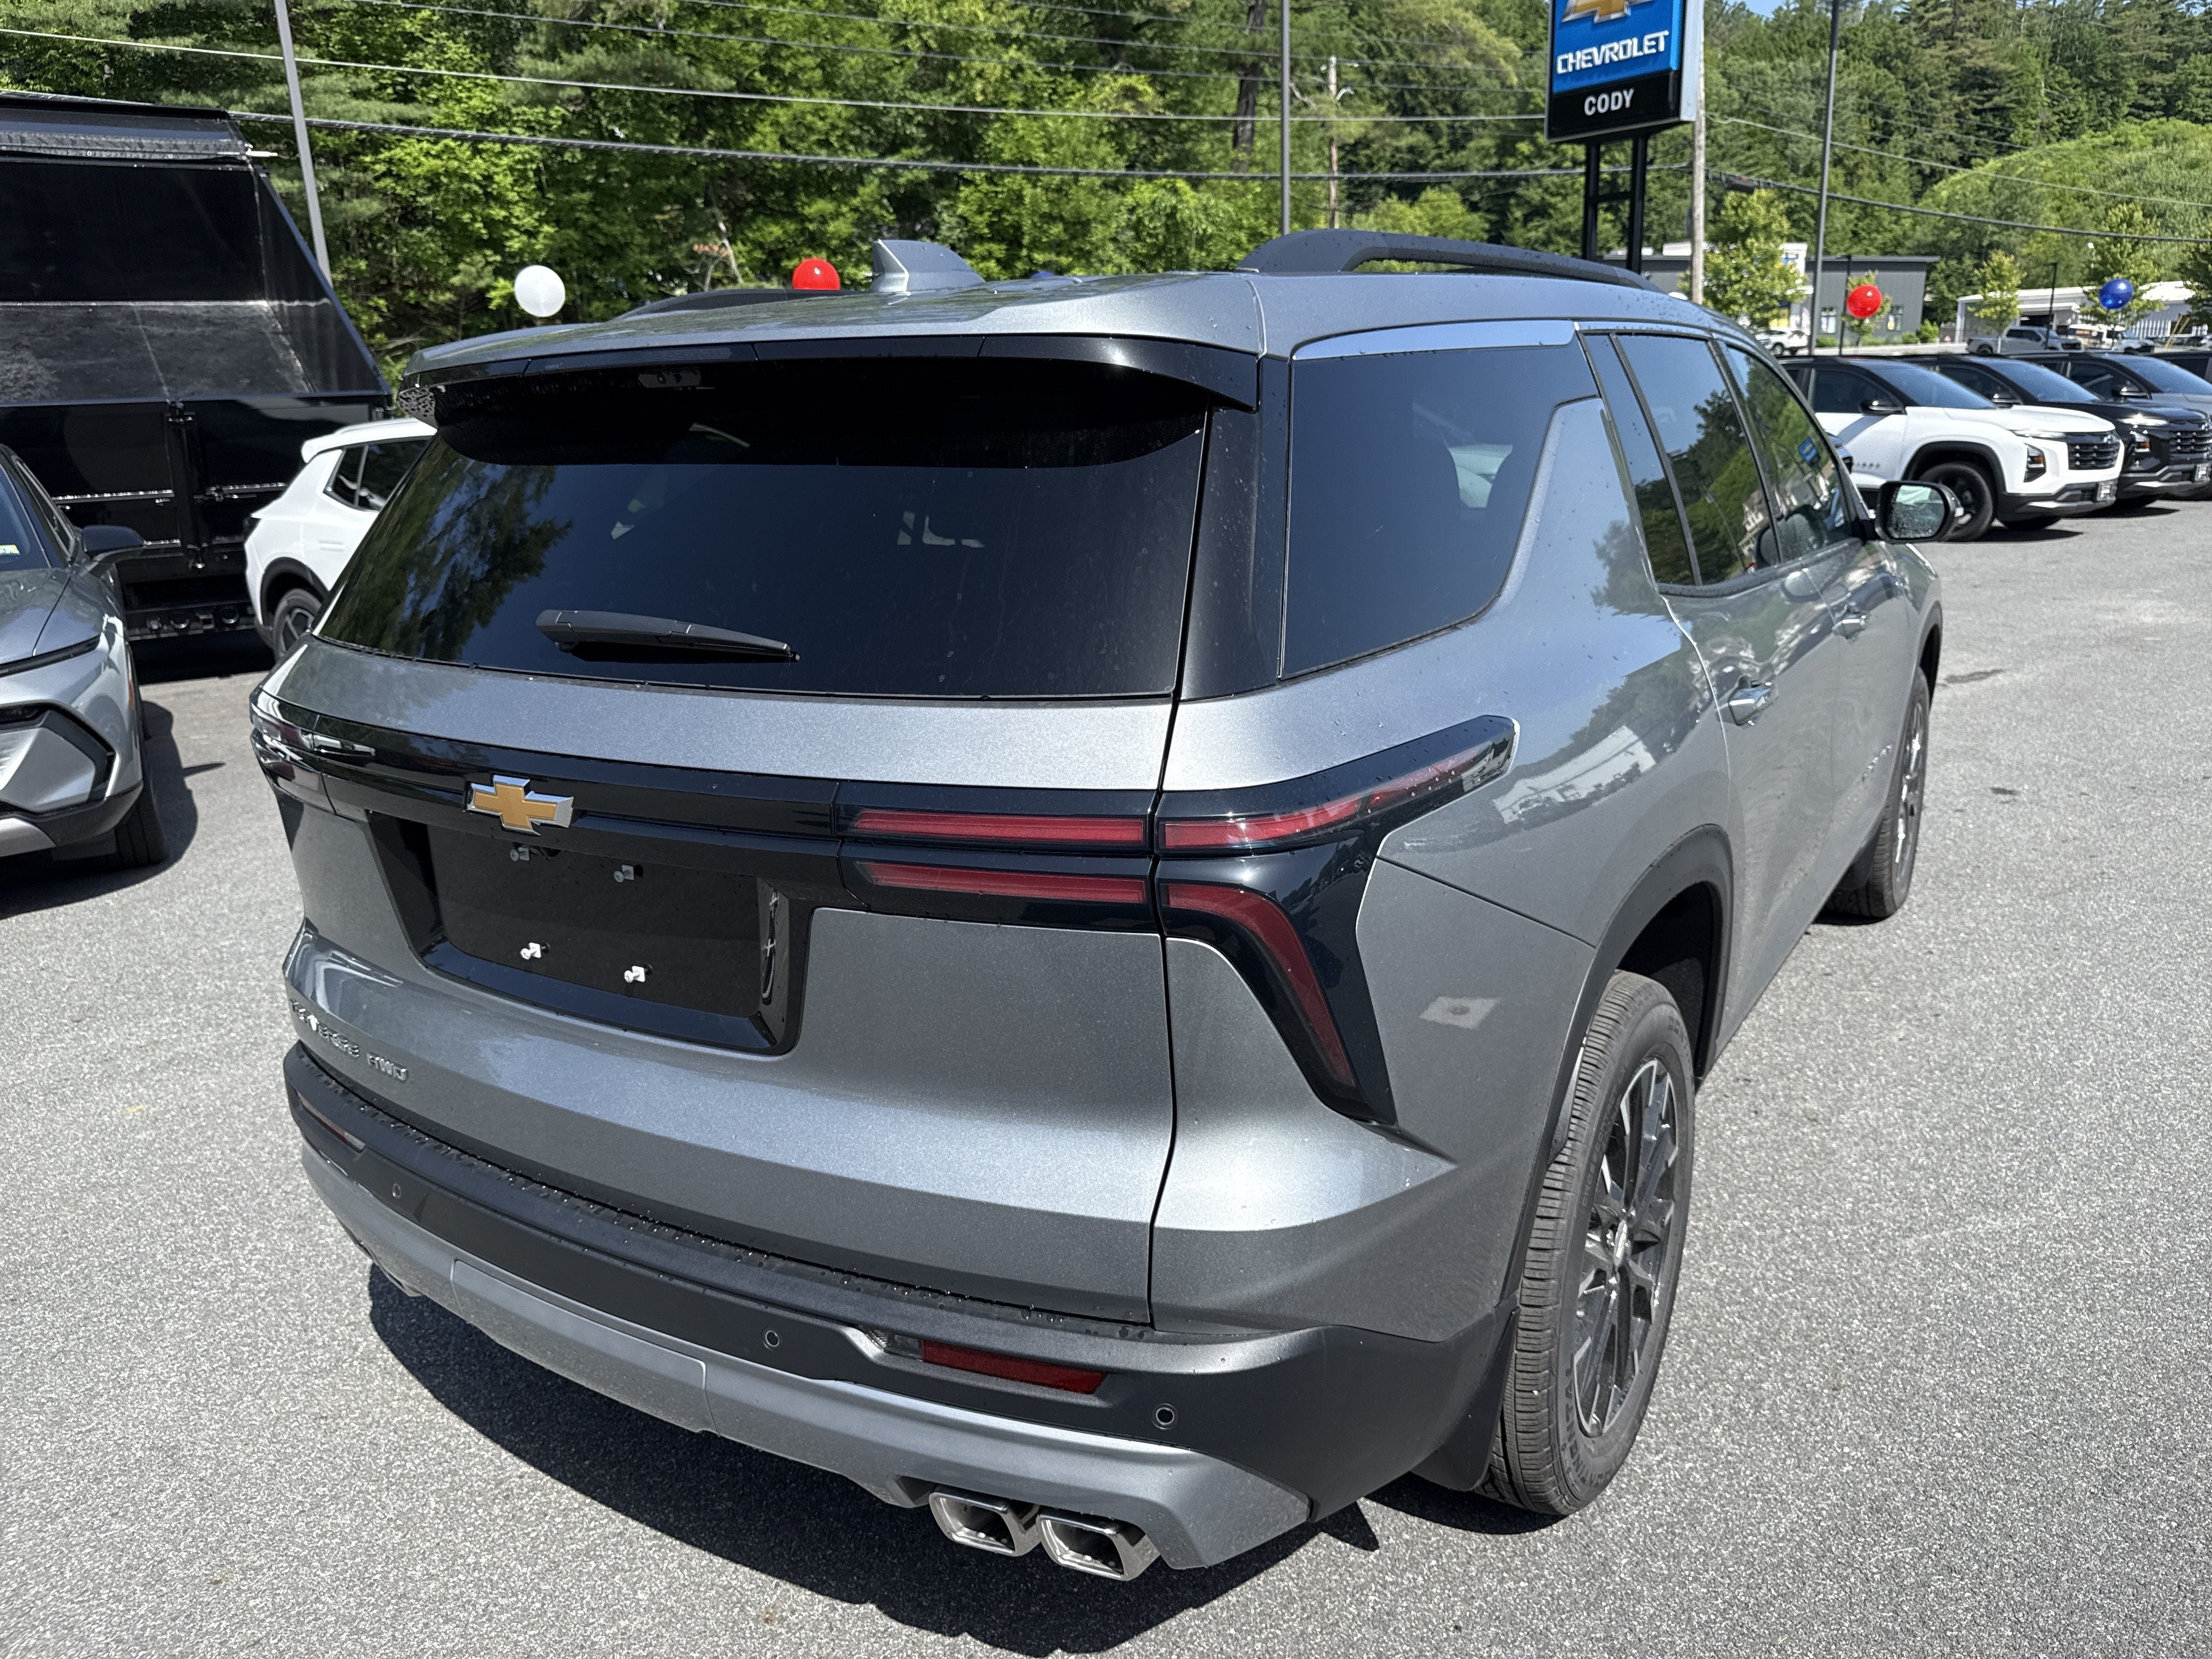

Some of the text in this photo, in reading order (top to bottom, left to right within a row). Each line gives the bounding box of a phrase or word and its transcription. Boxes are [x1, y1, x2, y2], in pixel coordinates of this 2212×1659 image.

[1556, 30, 1669, 75] CHEVROLET
[1584, 88, 1635, 116] CODY
[367, 1052, 409, 1082] AWD
